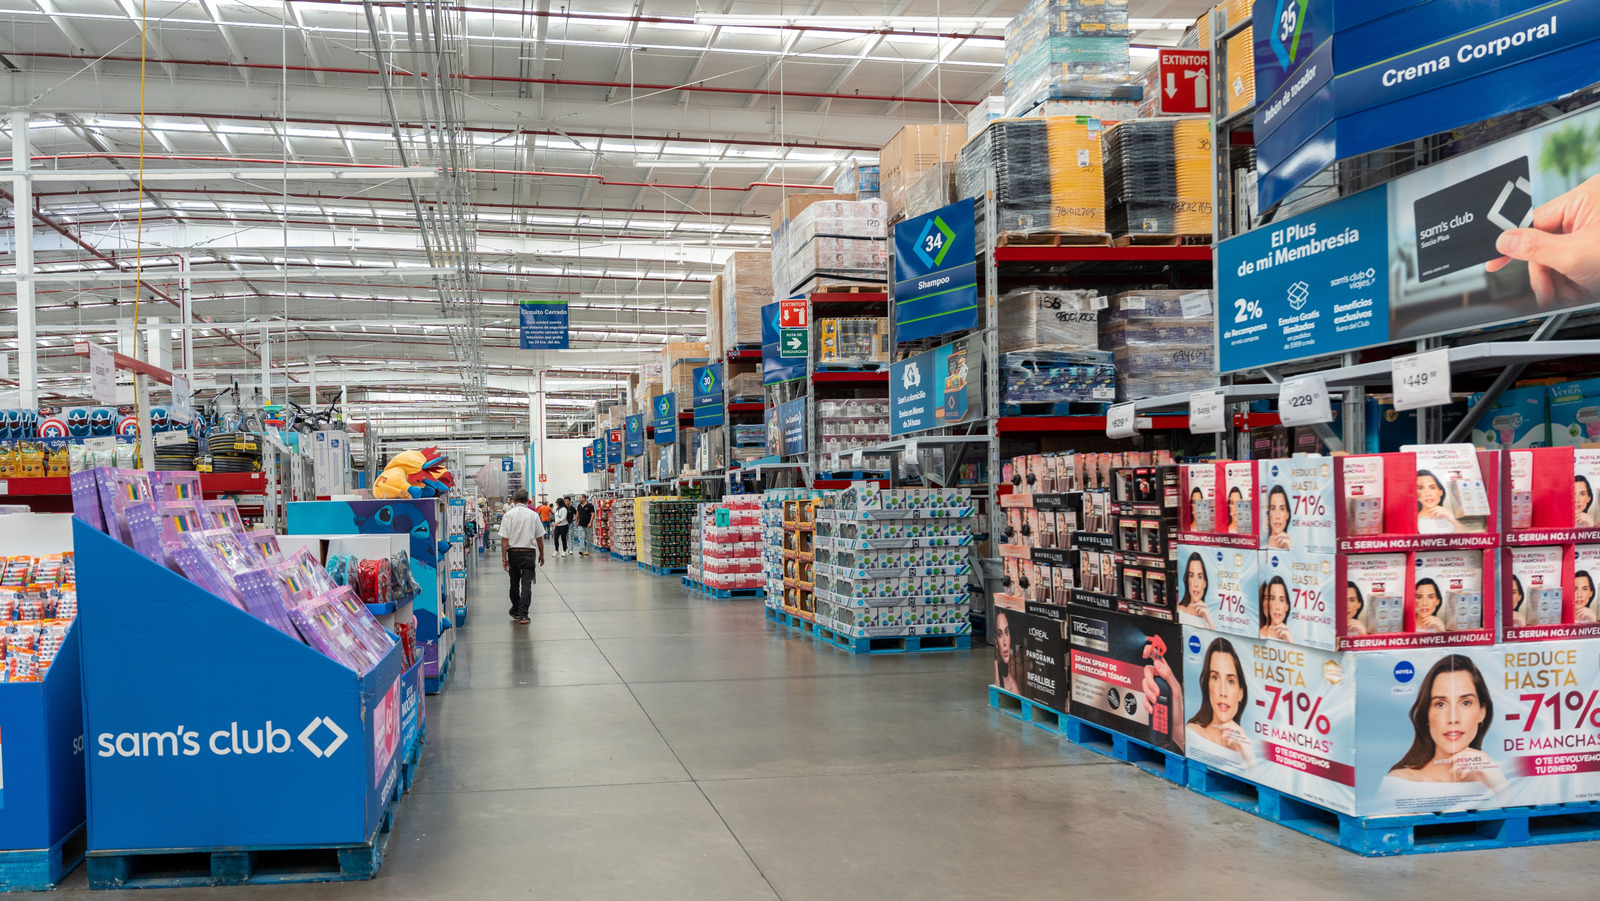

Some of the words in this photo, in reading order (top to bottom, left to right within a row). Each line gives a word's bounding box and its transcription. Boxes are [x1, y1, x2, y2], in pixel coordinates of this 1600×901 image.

[1281, 0, 1296, 41] 35
[1382, 50, 1450, 87] Crema
[1457, 16, 1557, 63] Corporal
[1162, 54, 1208, 65] EXTINTOR
[1264, 100, 1282, 124] Jabón
[1282, 90, 1291, 106] de
[1290, 65, 1317, 97] tocador
[1420, 221, 1449, 240] sam's
[1449, 211, 1474, 229] club
[925, 233, 943, 252] 34
[1271, 229, 1284, 248] El
[1286, 222, 1316, 243] Plus
[1437, 233, 1450, 244] Plus
[1237, 261, 1254, 277] de
[1256, 252, 1272, 272] mi
[1275, 227, 1359, 265] Membresía
[918, 275, 950, 290] Shampoo
[1330, 273, 1349, 287] sam's
[1349, 270, 1365, 281] club
[1349, 279, 1371, 290] viajes
[1234, 298, 1263, 324] 2%
[1334, 298, 1373, 314] Beneficios
[1278, 315, 1299, 326] Envíos
[1299, 310, 1320, 322] Gratis
[1334, 310, 1372, 325] exclusivos
[1357, 320, 1370, 329] Club
[1223, 331, 1231, 339] de
[1231, 323, 1267, 337] Recompensa
[704, 377, 711, 386] 30
[1403, 373, 1428, 386] $449
[1552, 386, 1581, 397] Venus
[1289, 394, 1312, 407] $229
[1291, 468, 1318, 476] REDUCE
[1292, 481, 1318, 491] HASTA
[1292, 495, 1325, 515] 71%
[1078, 536, 1113, 544] MAYBELLINE
[1578, 531, 1600, 539] NIVEL
[1341, 541, 1352, 549] EL
[1354, 540, 1388, 549] SERUM
[1390, 539, 1411, 548] NO.1
[1412, 539, 1419, 547] A
[1420, 538, 1448, 547] NIVEL
[1291, 562, 1318, 572] REDUCE
[1217, 570, 1239, 580] REDUCE
[1292, 576, 1318, 586] HASTA
[1217, 581, 1240, 592] HASTA
[1076, 594, 1110, 604] MAYBELLINE
[1218, 593, 1245, 614] 71%
[1292, 588, 1325, 612] 71%
[1029, 606, 1059, 616] MAYBELLINE
[1292, 612, 1300, 620] DE
[1519, 630, 1548, 638] SERUM
[1578, 627, 1600, 635] NIVEL
[1340, 640, 1351, 648] EL
[1353, 639, 1387, 647] SERUM
[1389, 638, 1410, 646] NO.1
[1411, 637, 1418, 645] A
[1420, 636, 1446, 644] NIVEL
[1026, 649, 1055, 665] PANORAMA
[1074, 655, 1092, 664] 2PACK
[1092, 659, 1109, 669] SPRAY
[1253, 645, 1304, 667] REDUCE
[1504, 650, 1577, 668] REDUCE
[1027, 671, 1055, 689] INFAILLIBLE
[1075, 663, 1107, 678] PROTECCIÓN
[1107, 671, 1131, 684] TÉRMICA
[1253, 662, 1306, 688] HASTA
[1504, 669, 1578, 690] HASTA
[1256, 684, 1331, 735] -71%
[1255, 721, 1269, 736] DE
[97, 725, 201, 757] sam's
[208, 720, 292, 755] club
[1504, 739, 1524, 751] DE
[1275, 746, 1281, 754] O
[1281, 748, 1289, 756] TE
[1289, 749, 1330, 769] DEVOLVEMOS
[1275, 755, 1284, 764] TU
[1284, 757, 1307, 770] DINERO
[1535, 756, 1544, 765] O
[1544, 756, 1553, 764] TE
[1554, 753, 1600, 764] DEVOLVEMO
[1535, 766, 1546, 774] TU
[1547, 764, 1577, 773] DINERO
